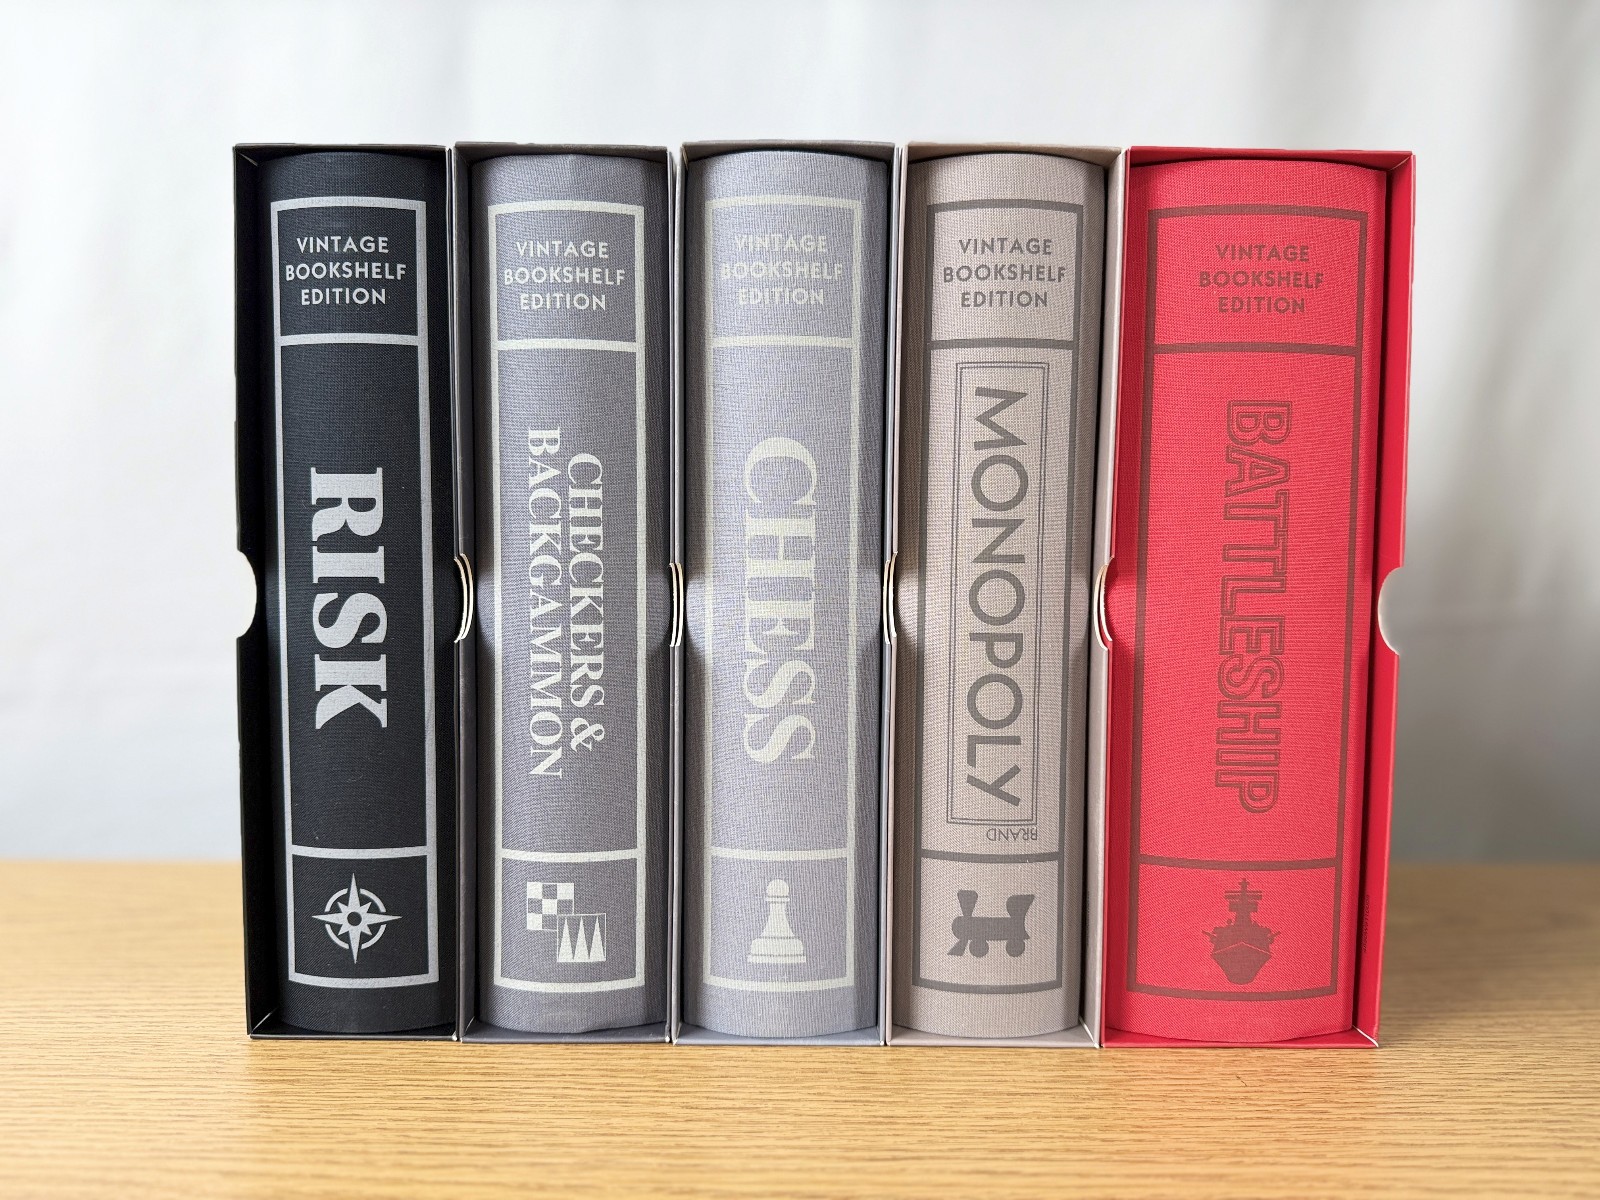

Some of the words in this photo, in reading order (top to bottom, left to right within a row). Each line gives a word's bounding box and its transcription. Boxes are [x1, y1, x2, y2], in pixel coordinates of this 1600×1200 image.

[296, 235, 389, 253] VINTAGE
[515, 240, 609, 258] VINTAGE
[734, 235, 828, 253] VINTAGE
[958, 237, 1052, 255] VINTAGE
[1215, 243, 1309, 262] VINTAGE
[285, 261, 407, 282] BOOKSHELF
[504, 266, 626, 287] BOOKSHELF
[721, 262, 844, 280] BOOKSHELF
[943, 264, 1066, 284] BOOKSHELF
[1199, 270, 1325, 290] BOOKSHELF
[300, 287, 386, 306] EDITION
[519, 292, 607, 312] EDITION
[738, 289, 824, 306] EDITION
[960, 289, 1048, 309] EDITION
[1218, 295, 1307, 315] EDITION
[568, 452, 606, 709] CHECKERS
[310, 467, 388, 730] RISK
[526, 428, 563, 779] BACKGAMMON
[744, 437, 818, 763] CHESS
[965, 387, 1028, 807] MONOPOLY
[1216, 401, 1291, 814] BATTLESHIP
[571, 720, 606, 752] &
[986, 826, 1038, 842] BRAND
